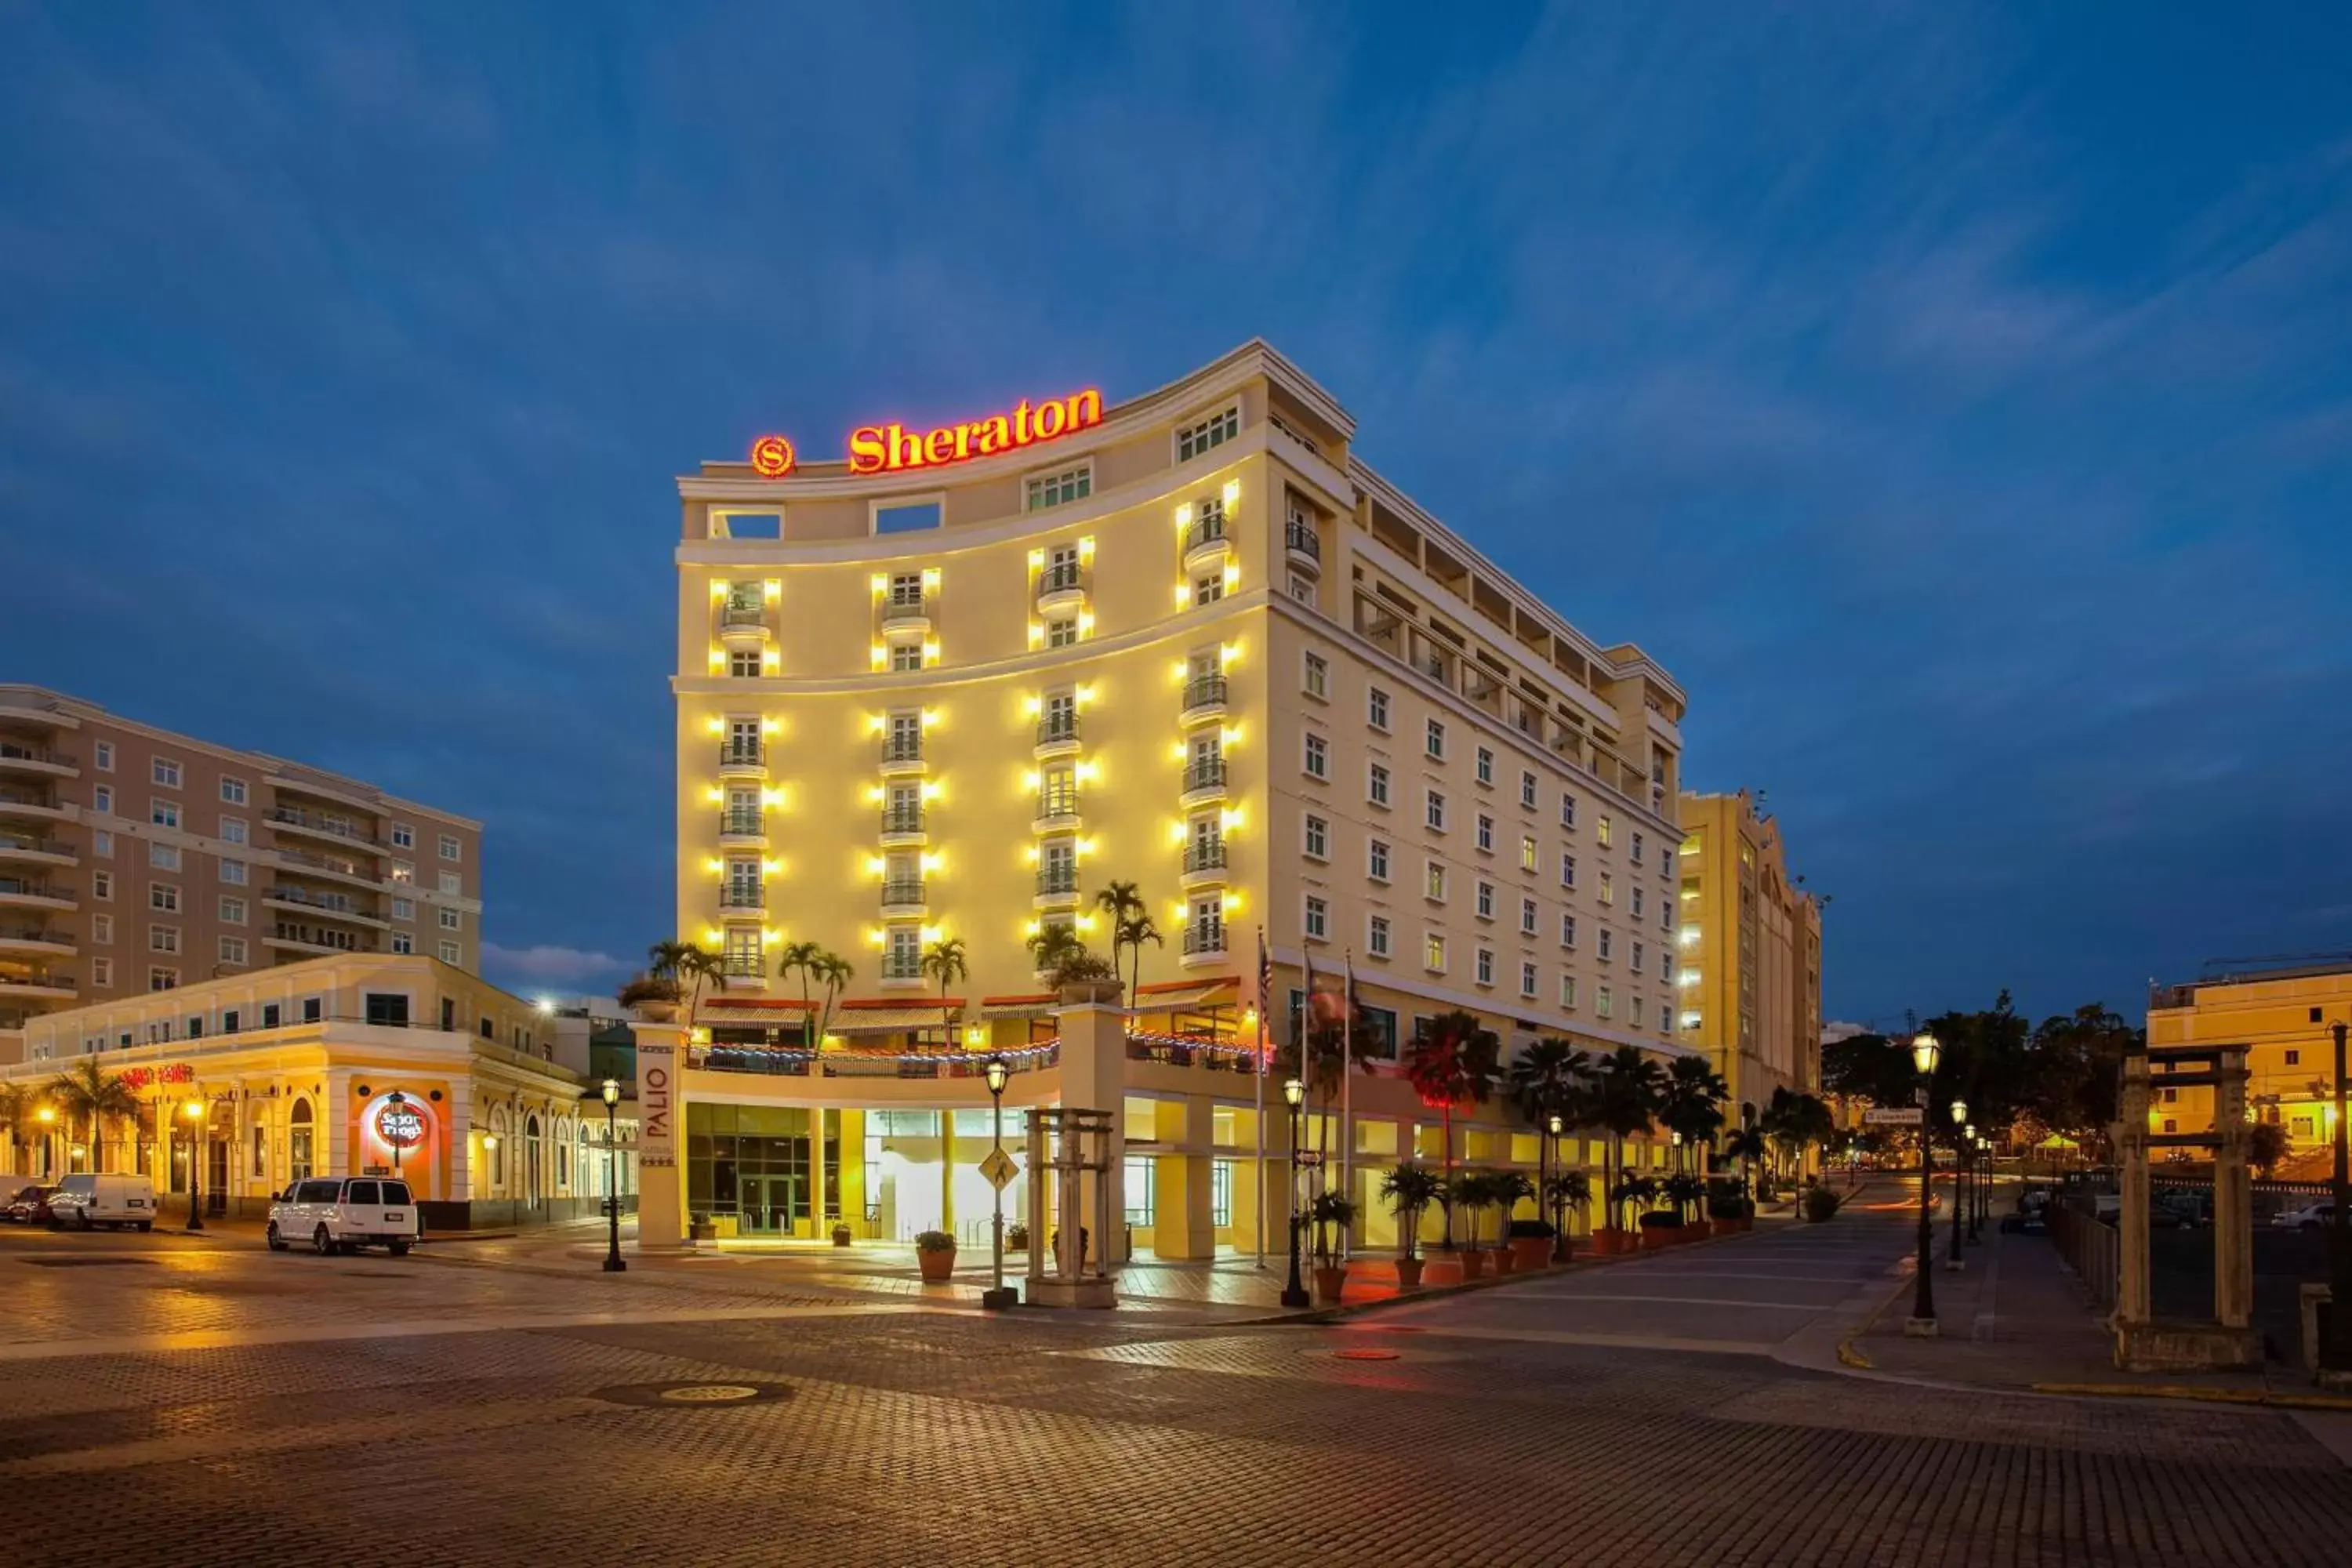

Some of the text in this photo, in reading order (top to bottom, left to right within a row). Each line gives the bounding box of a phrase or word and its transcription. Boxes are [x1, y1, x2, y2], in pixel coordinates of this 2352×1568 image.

[761, 443, 783, 467] S
[850, 389, 1102, 474] Sheraton
[646, 1068, 668, 1137] PALIO
